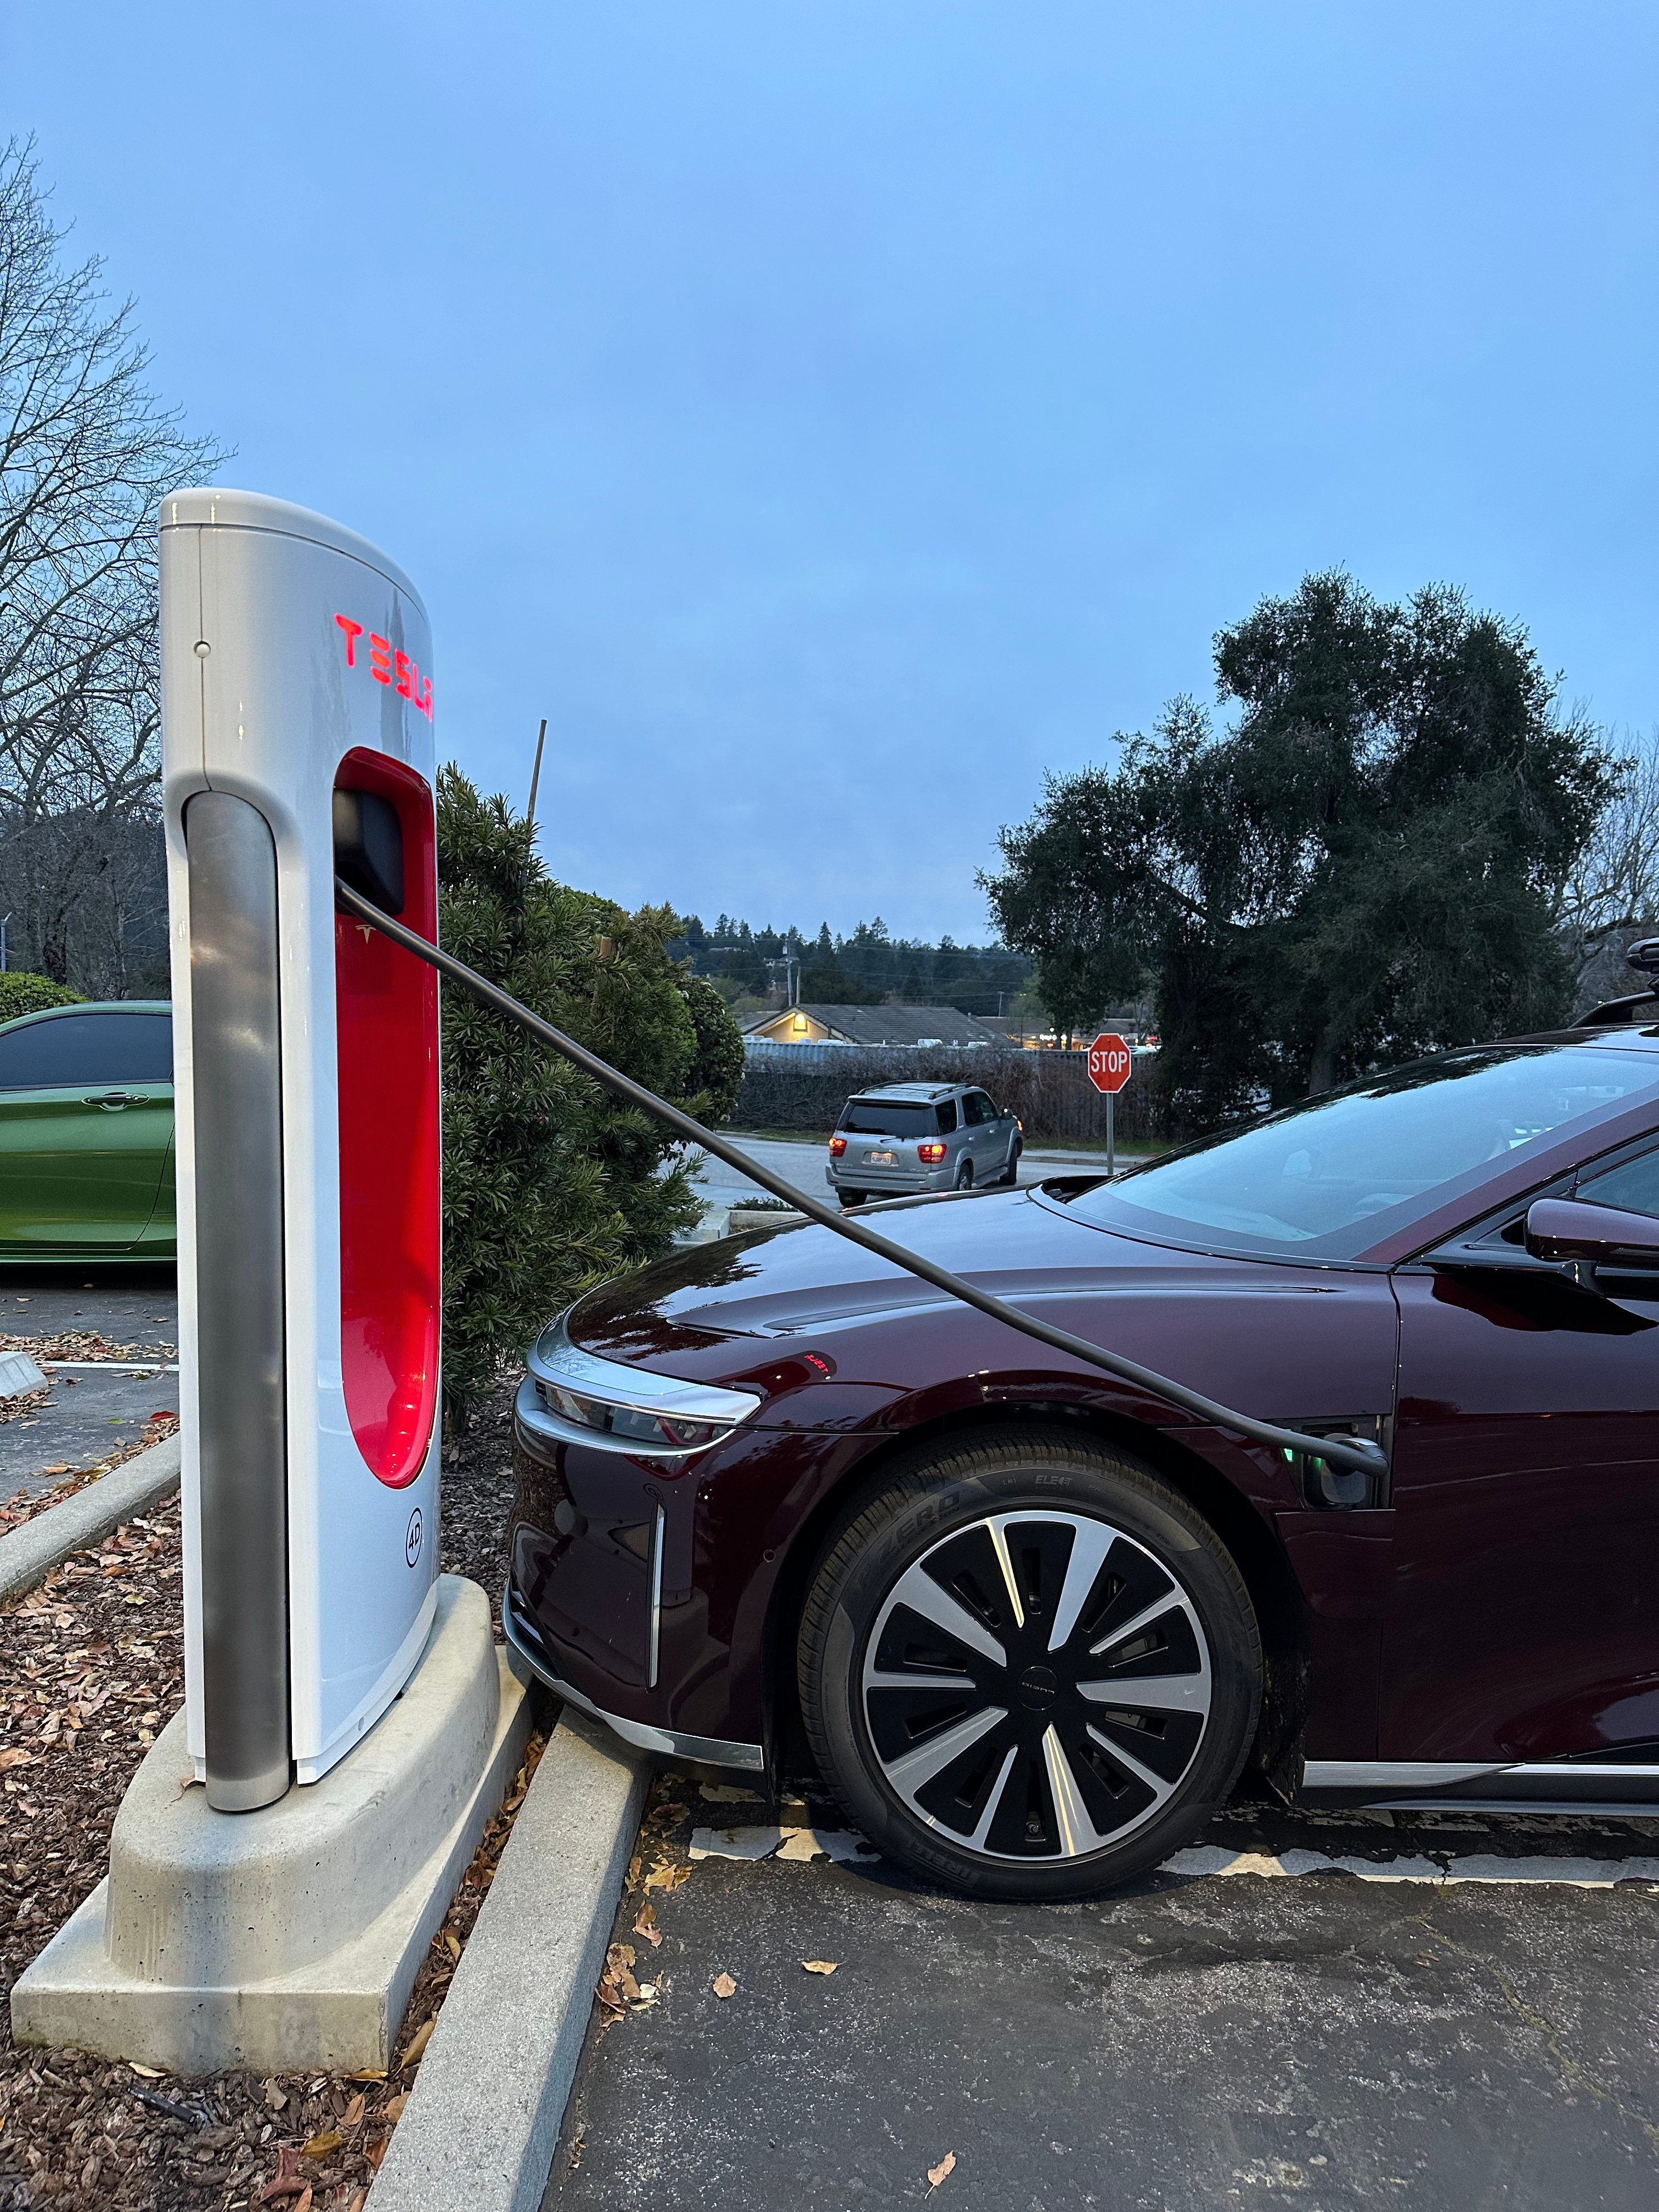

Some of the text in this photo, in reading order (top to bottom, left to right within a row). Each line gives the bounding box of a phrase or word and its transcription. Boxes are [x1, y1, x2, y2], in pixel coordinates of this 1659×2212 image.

[334, 613, 433, 723] TESLA
[1091, 1051, 1128, 1073] STOP
[408, 1522, 421, 1550] 4D
[1022, 1682, 1054, 1694] LUCID
